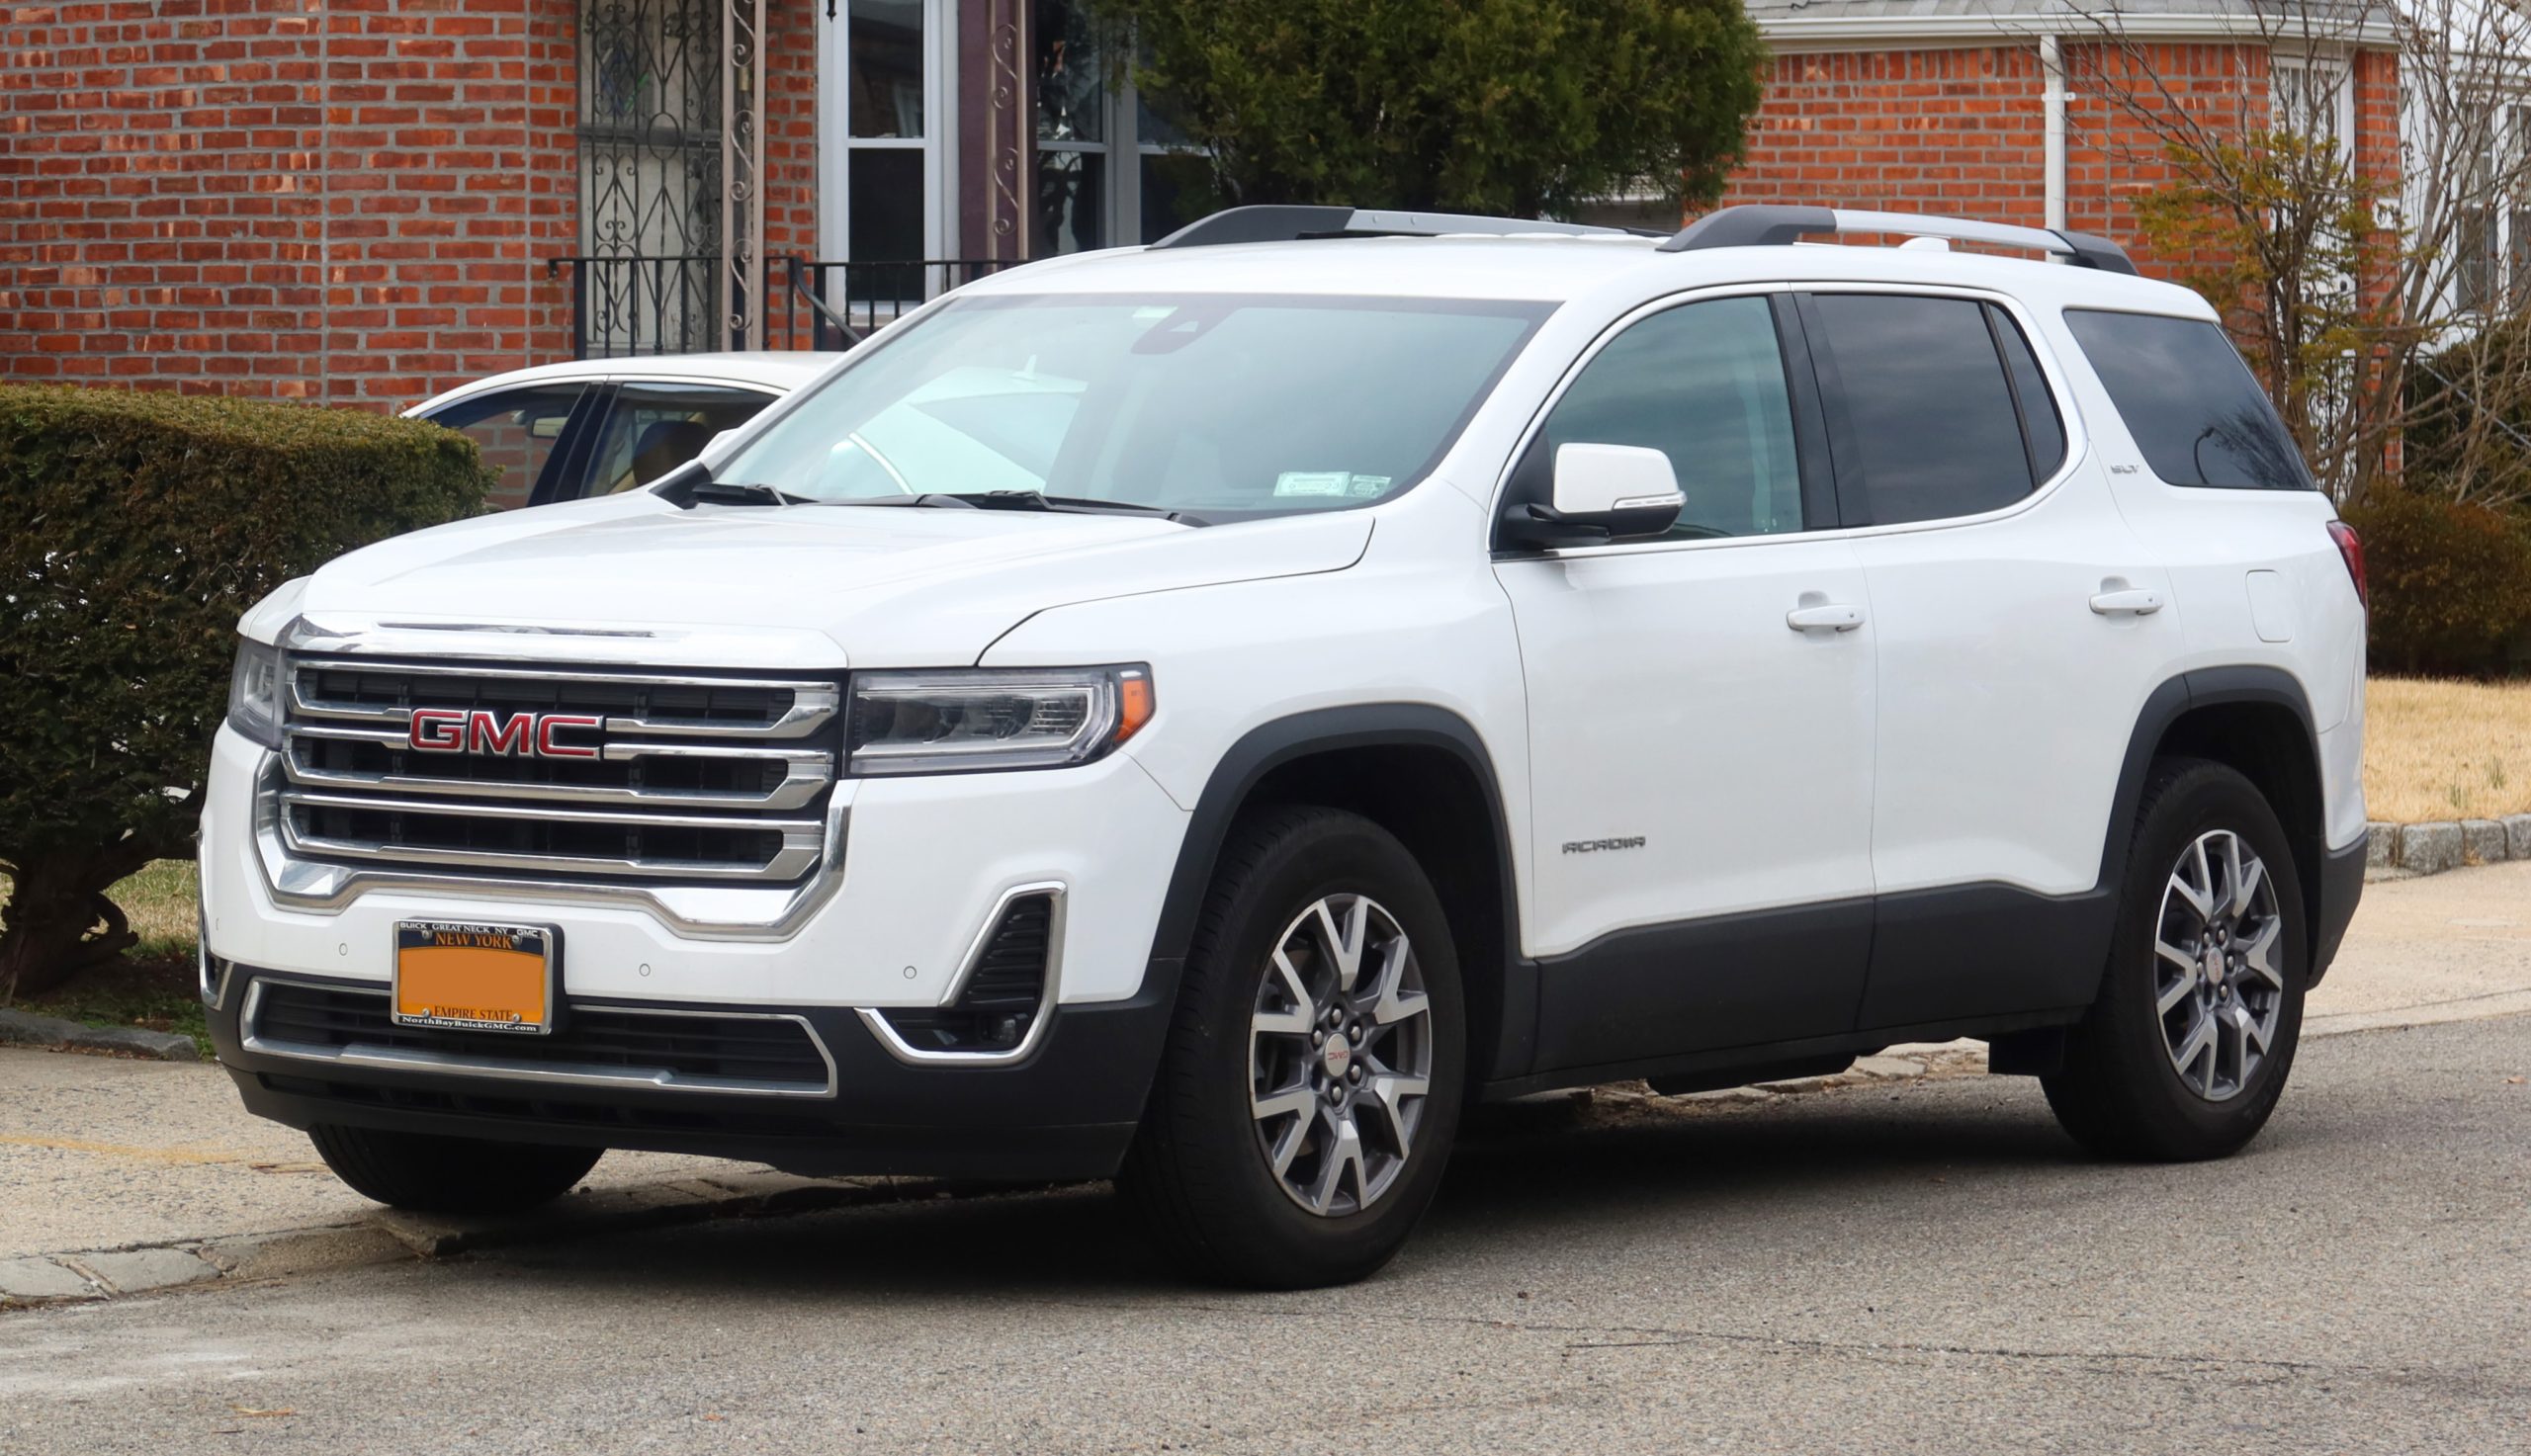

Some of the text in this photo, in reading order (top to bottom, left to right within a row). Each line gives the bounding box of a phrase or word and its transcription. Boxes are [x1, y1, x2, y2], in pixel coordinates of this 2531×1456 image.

[409, 708, 604, 761] GMC
[1562, 836, 1646, 854] ACADIA
[464, 925, 490, 934] NECK
[495, 926, 509, 935] NY
[517, 929, 538, 938] GMC
[435, 932, 513, 950] NEW YORK
[434, 1005, 513, 1022] EMPIRE STATE
[401, 1017, 537, 1032] NorthBayBuickGMC.com
